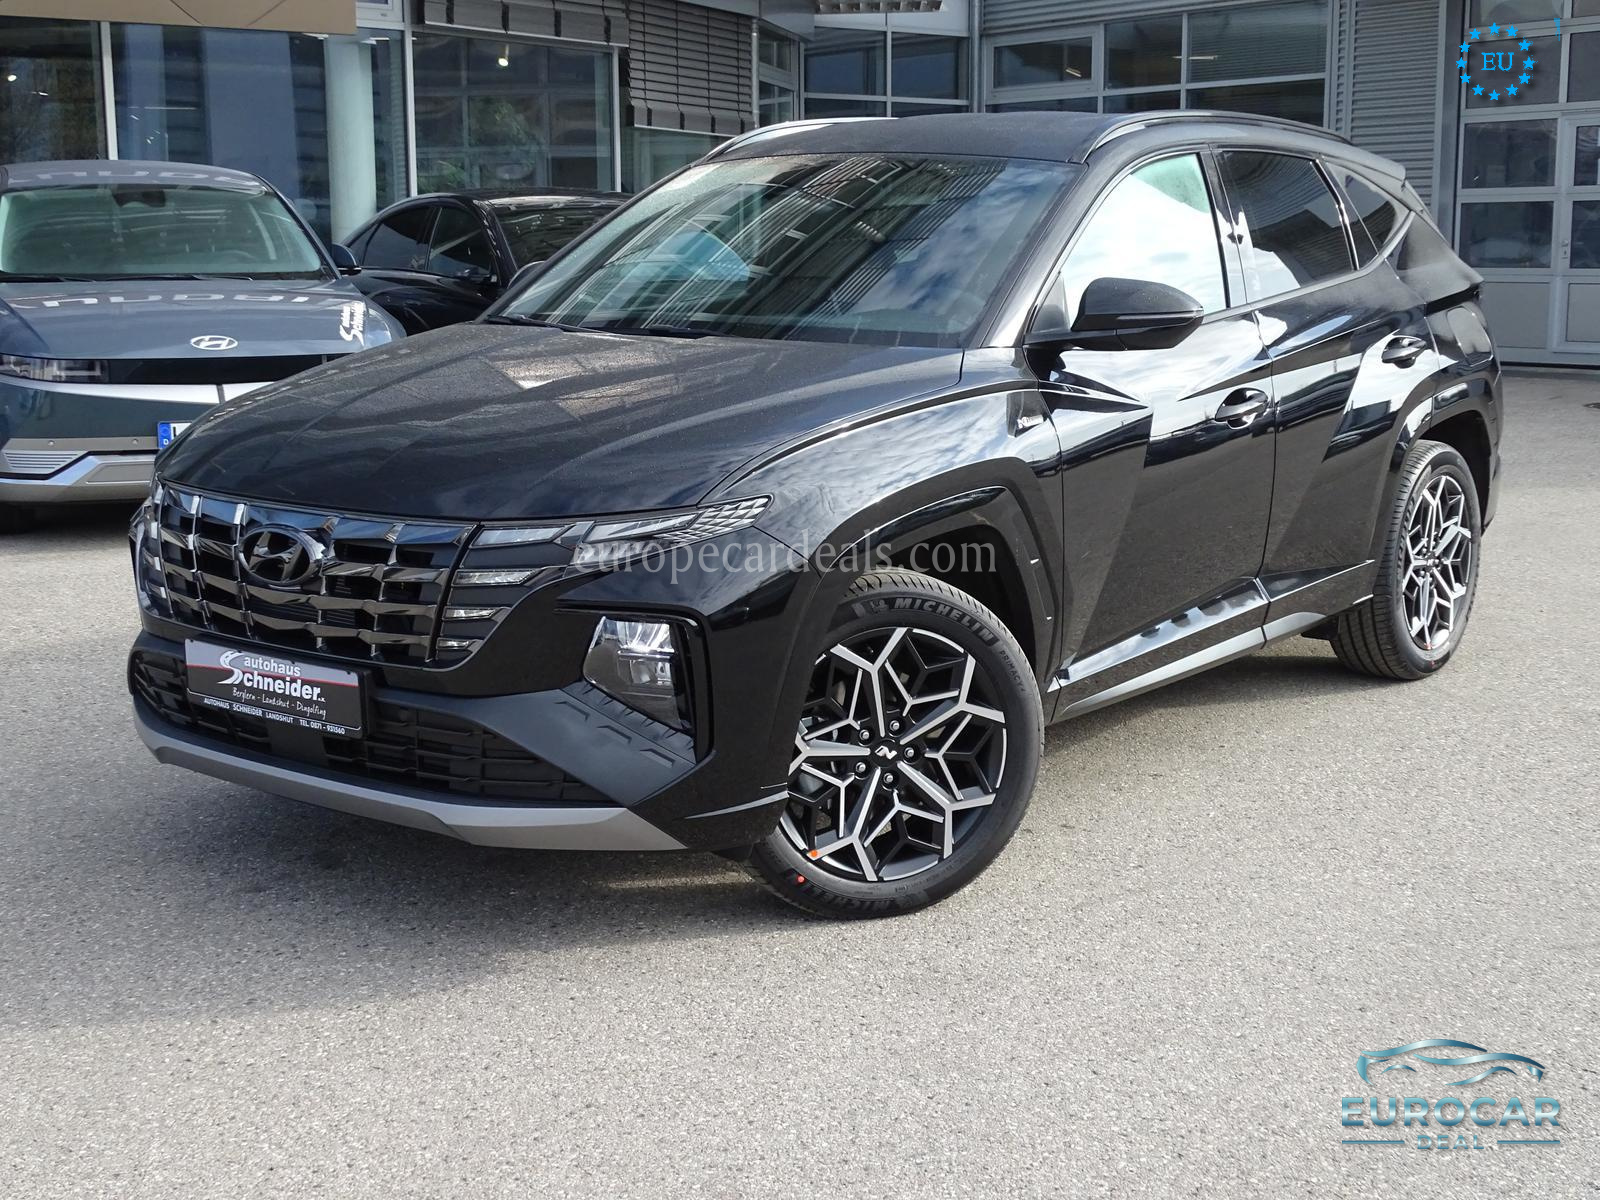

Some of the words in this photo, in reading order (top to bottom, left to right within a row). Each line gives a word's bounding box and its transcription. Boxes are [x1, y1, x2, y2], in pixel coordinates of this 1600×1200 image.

[894, 597, 994, 643] MICHELIN
[244, 656, 301, 677] autohaus
[1000, 650, 1024, 687] PRIMACY
[203, 698, 230, 709] AUTOHAUS
[232, 704, 263, 717] SCHNEIDER
[266, 712, 294, 724] LANDSHUT
[262, 693, 290, 709] Landshut
[296, 701, 327, 720] Dingolfing
